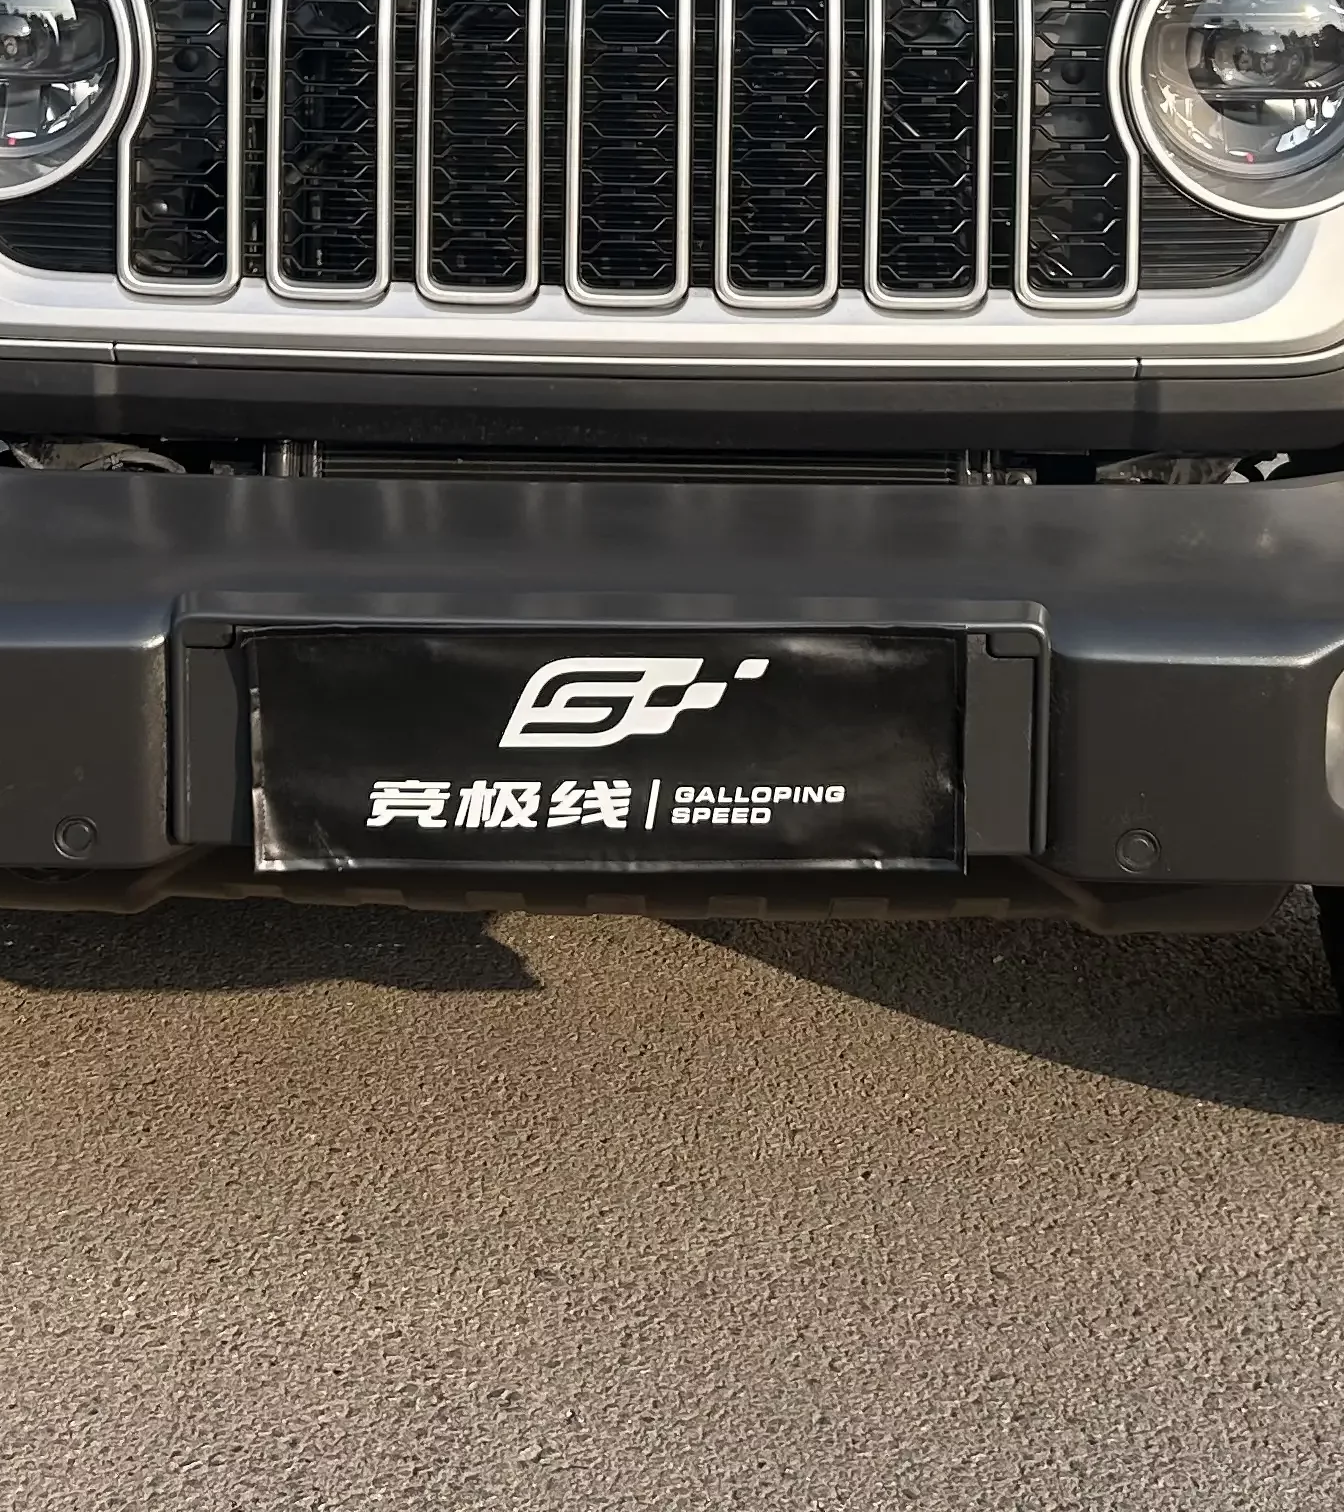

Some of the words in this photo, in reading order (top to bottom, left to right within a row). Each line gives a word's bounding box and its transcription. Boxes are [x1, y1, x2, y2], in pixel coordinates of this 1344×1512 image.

[366, 780, 632, 829] 竞极线
[674, 785, 845, 805] GALLOPING
[671, 807, 772, 825] SPEED
